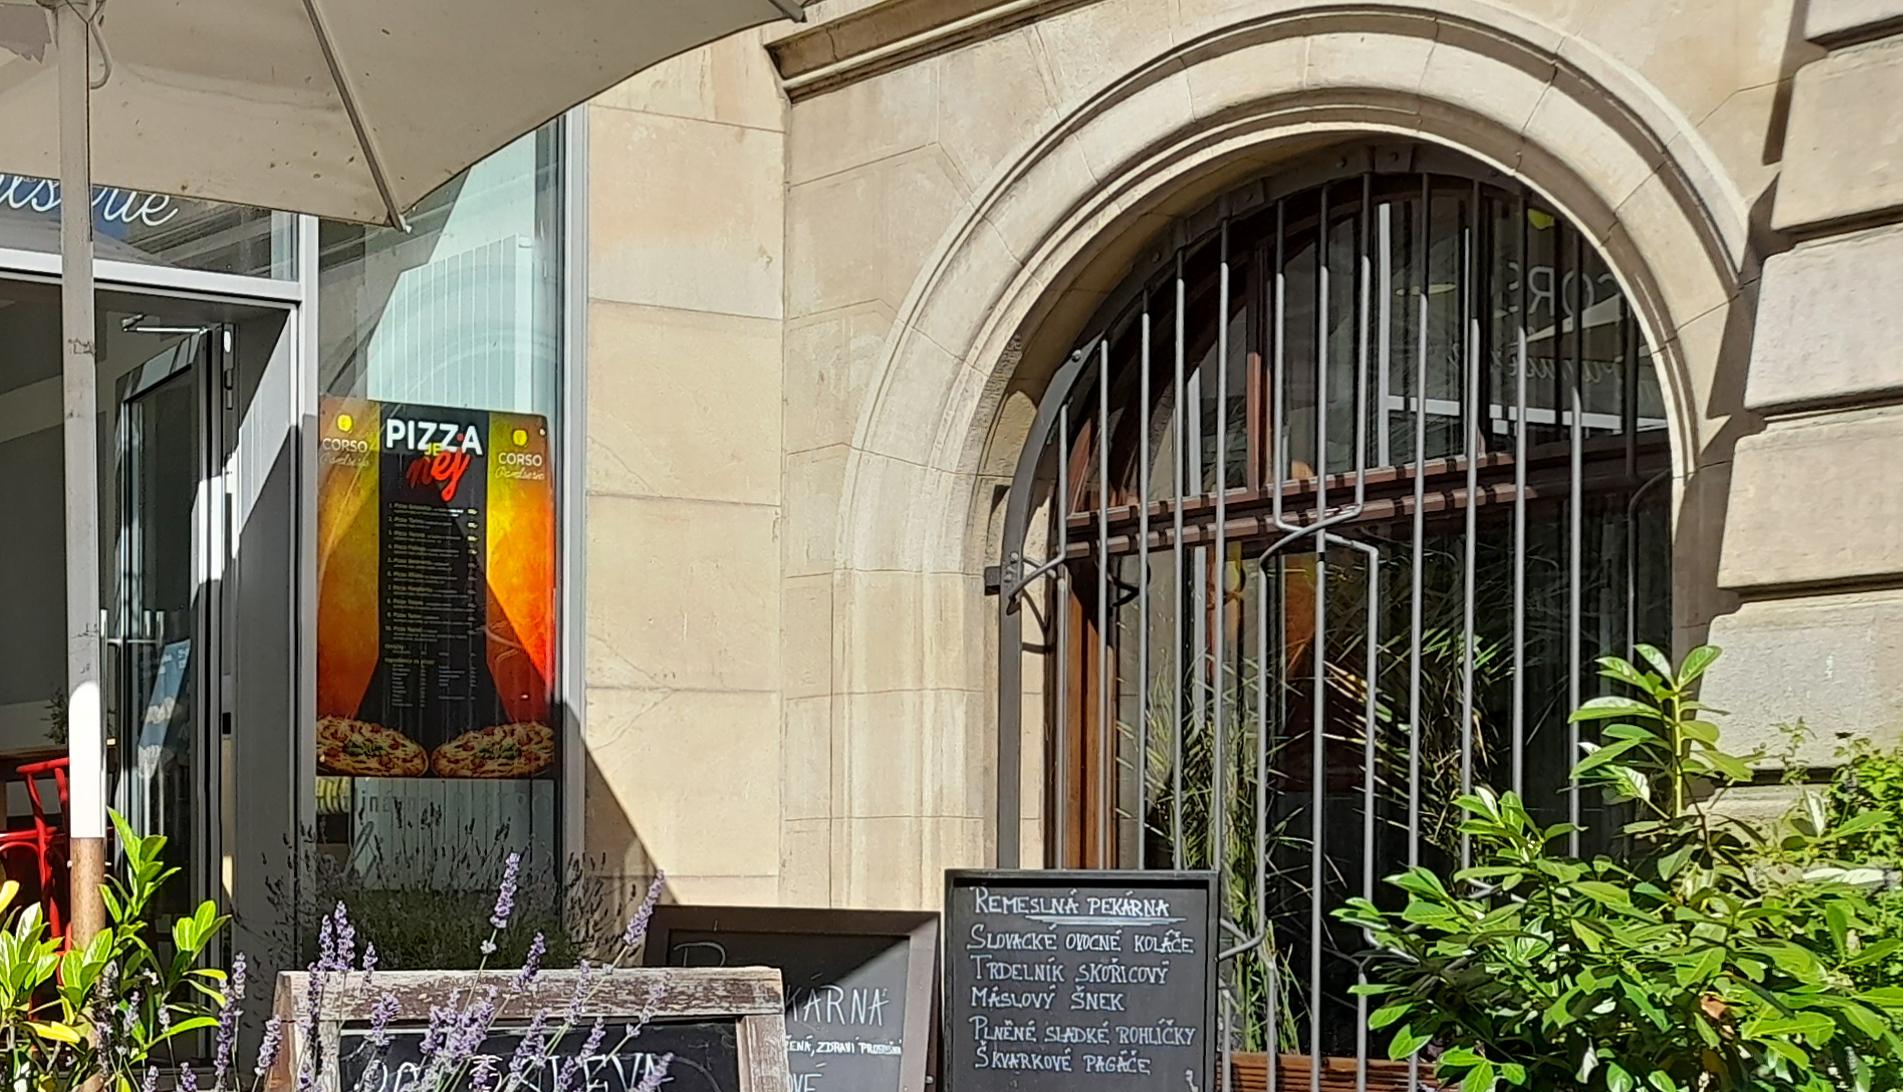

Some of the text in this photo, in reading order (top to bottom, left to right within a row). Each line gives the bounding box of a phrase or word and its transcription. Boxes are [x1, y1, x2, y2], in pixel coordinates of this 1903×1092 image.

[322, 437, 369, 453] CORSO
[384, 418, 484, 457] PIZZA
[497, 451, 543, 468] CORSO
[1087, 889, 1170, 917] PEKÁRNA
[1065, 929, 1122, 952] OVOCNÉ
[1134, 929, 1195, 954] KOLÁČE
[969, 954, 1170, 985] TRDELNÍK SKOŘICOVÝ
[786, 972, 889, 1026] KÁRNA
[970, 984, 1125, 1011] MÁSLOVÝ ŠNEK
[968, 1015, 1197, 1046] PLNĚNÉ SLADKÉ ROHLÍČKY
[974, 1040, 1151, 1076] ŠKVARKOVÉ PAGÁČE
